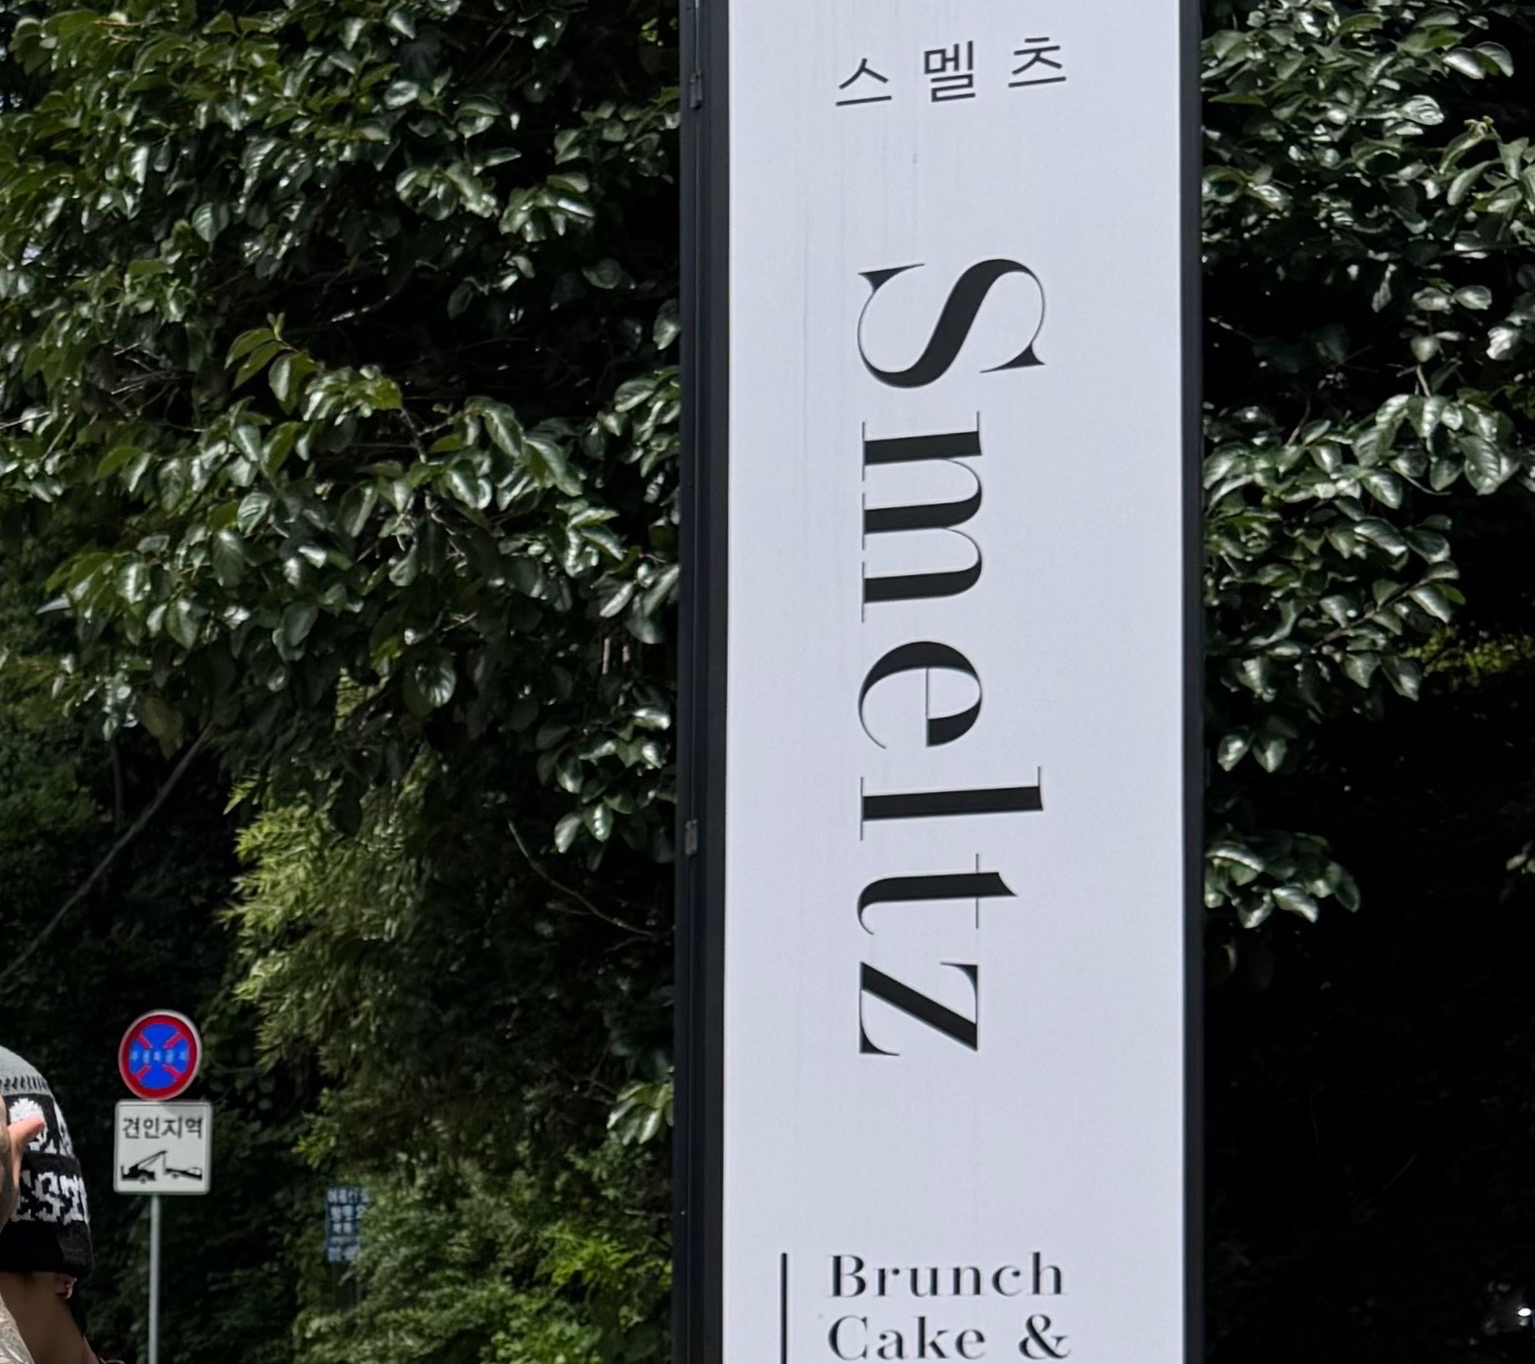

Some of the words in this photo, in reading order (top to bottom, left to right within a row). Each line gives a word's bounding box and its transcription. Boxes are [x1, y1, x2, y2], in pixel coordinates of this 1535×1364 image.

[835, 36, 1067, 107] 스멜츠
[857, 258, 1047, 1057] Smeltz
[122, 1116, 203, 1140] 견인지역
[826, 1251, 1068, 1299] Brunch
[826, 1314, 987, 1361] Cake
[1017, 1313, 1072, 1361] &
